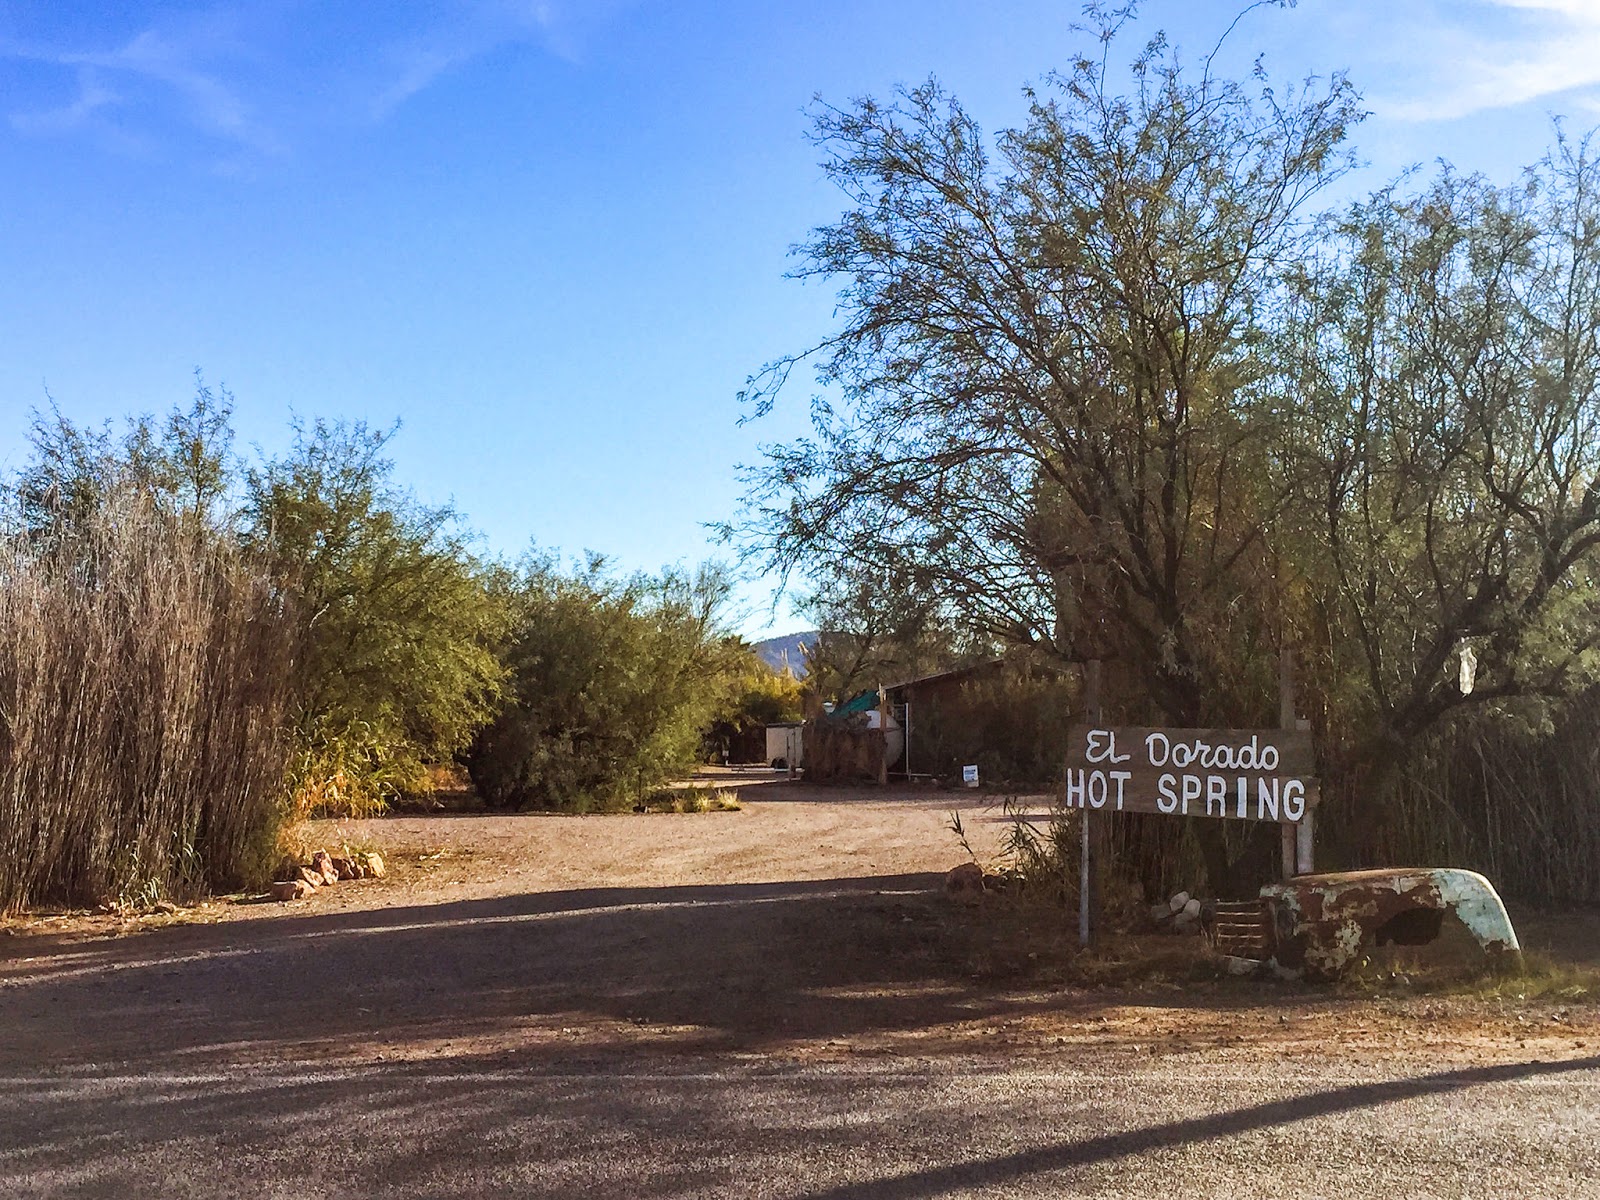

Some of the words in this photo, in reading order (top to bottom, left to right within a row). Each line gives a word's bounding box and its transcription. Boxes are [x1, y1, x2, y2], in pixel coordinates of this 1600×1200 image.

[1145, 732, 1280, 770] Dorado
[1066, 767, 1132, 810] HOT
[1156, 773, 1305, 821] SPRING
